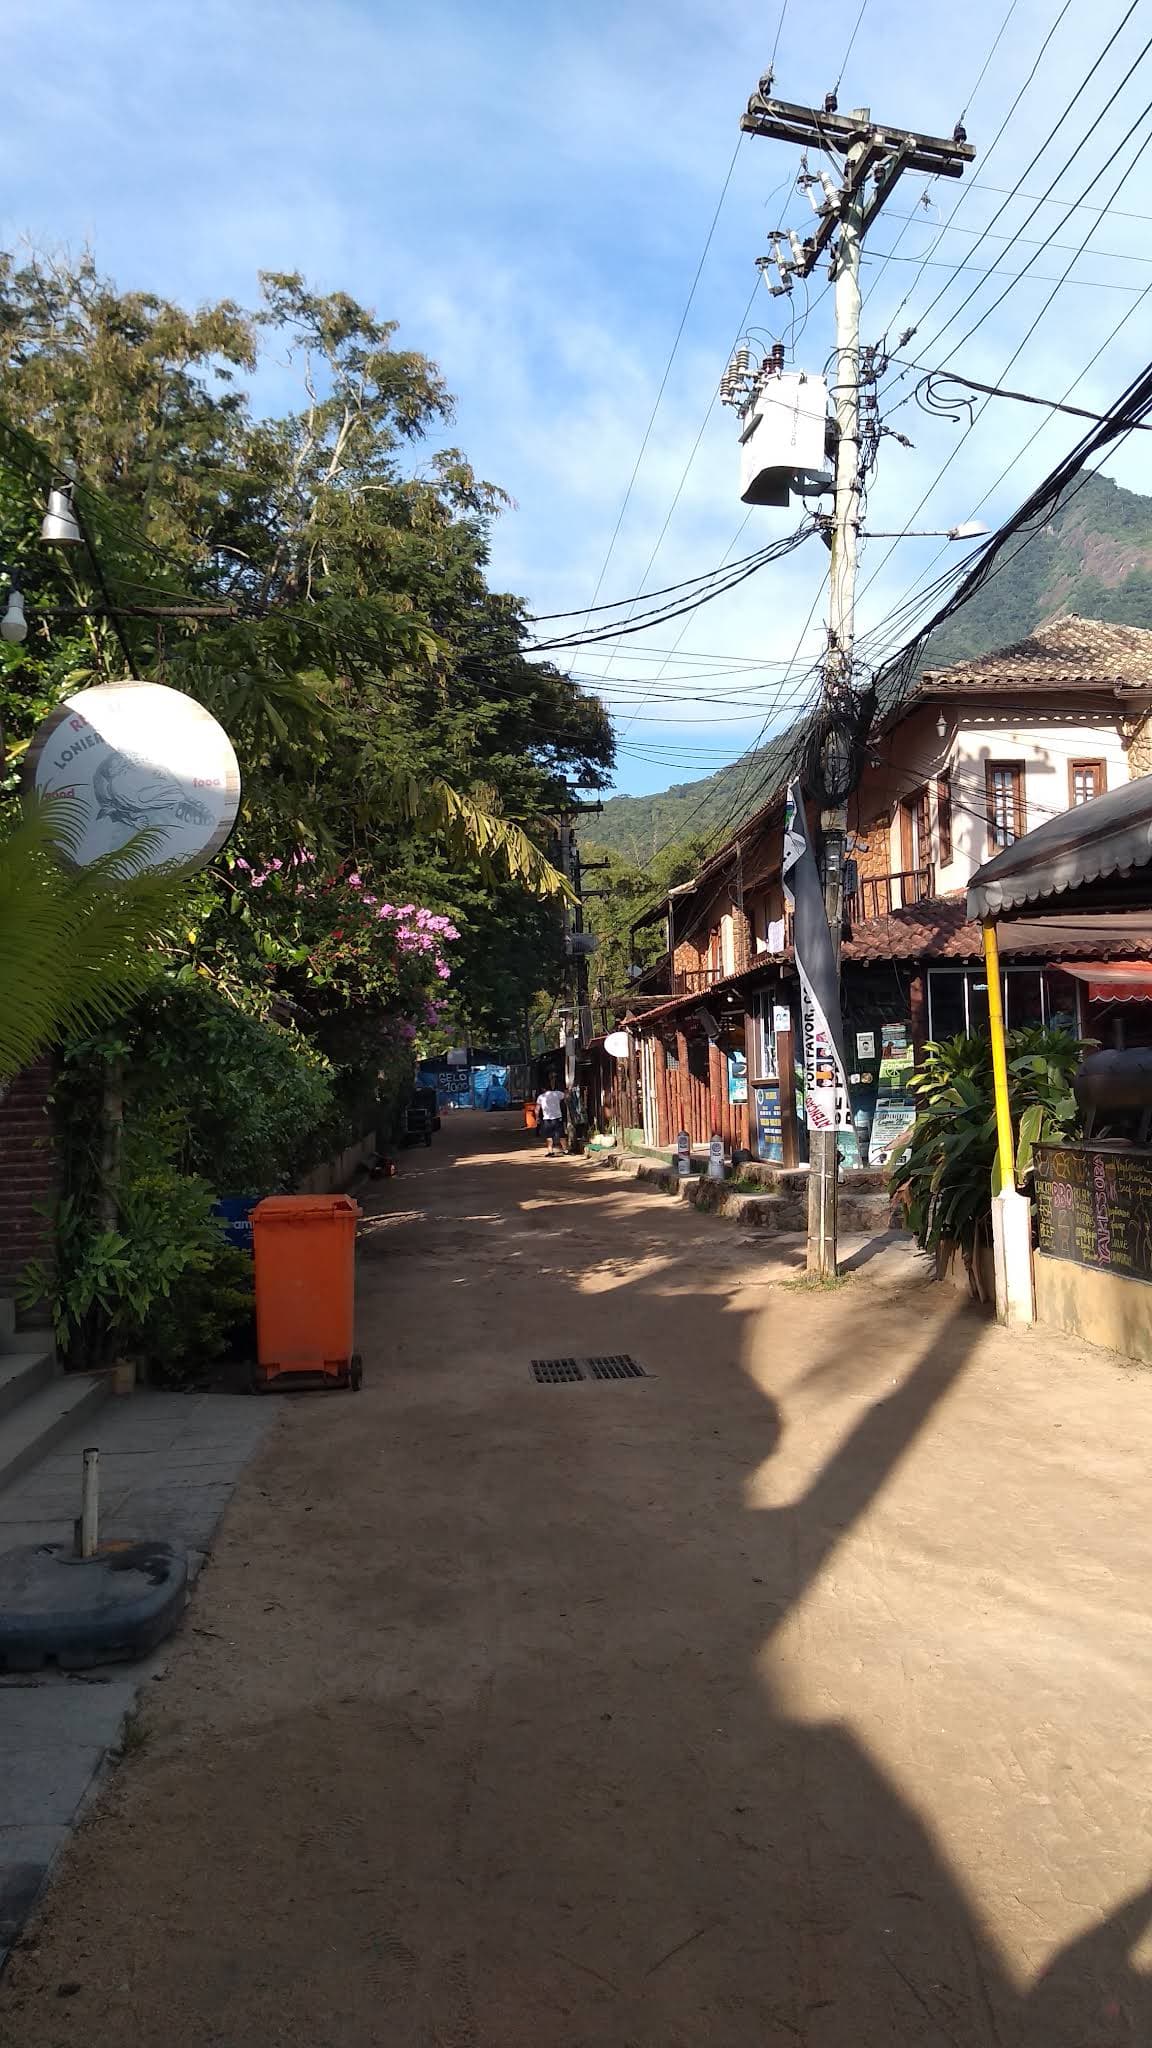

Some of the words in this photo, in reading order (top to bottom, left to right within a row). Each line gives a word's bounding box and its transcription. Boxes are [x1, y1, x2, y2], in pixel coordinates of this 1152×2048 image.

[803, 1009, 816, 1058] FAVOR,
[805, 1063, 815, 1091] POR
[1052, 1181, 1073, 1210] BBQ
[1092, 1154, 1111, 1266] YAKISSOBA
